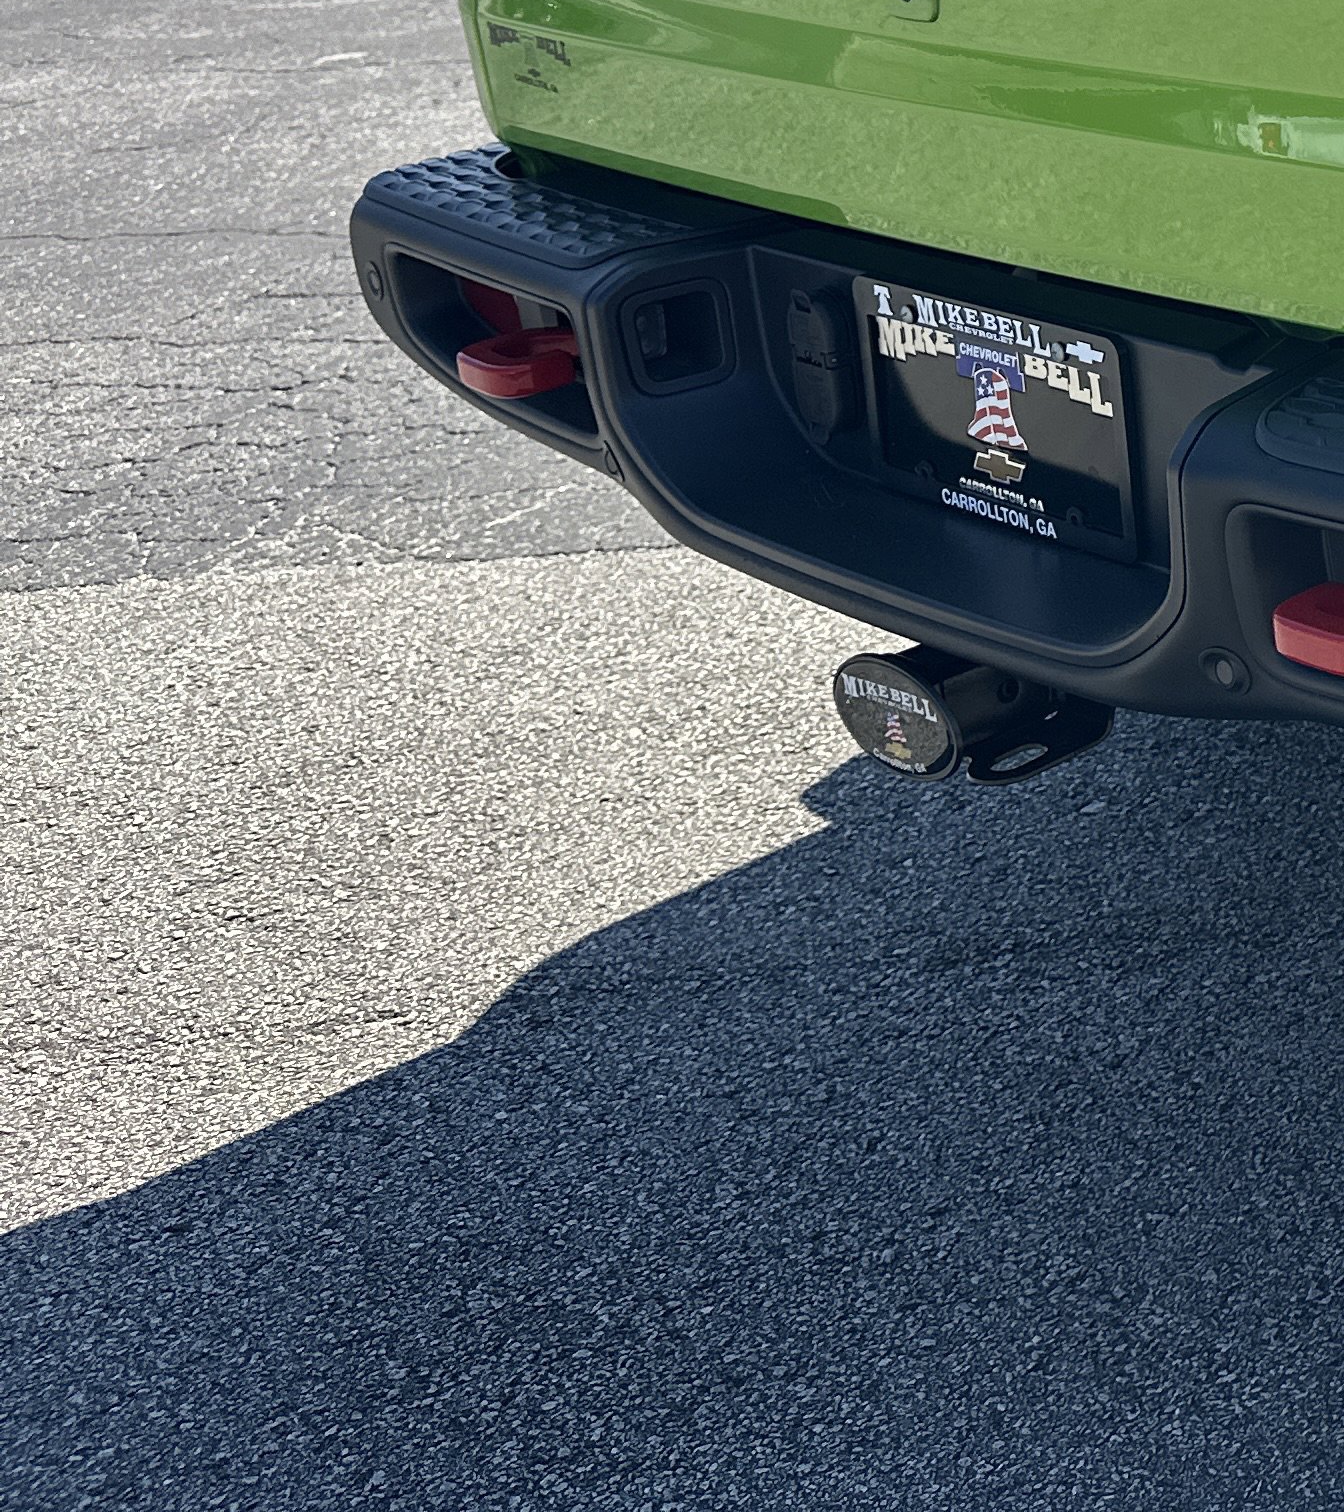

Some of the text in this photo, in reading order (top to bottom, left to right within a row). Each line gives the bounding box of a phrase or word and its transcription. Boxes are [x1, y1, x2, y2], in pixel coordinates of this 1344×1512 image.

[876, 315, 955, 362] MIKE
[949, 321, 1014, 346] CHEVROLET
[958, 341, 1018, 368] CHEVROLET
[1023, 353, 1114, 419] BELL
[941, 488, 1058, 540] CARROLLTON, GA
